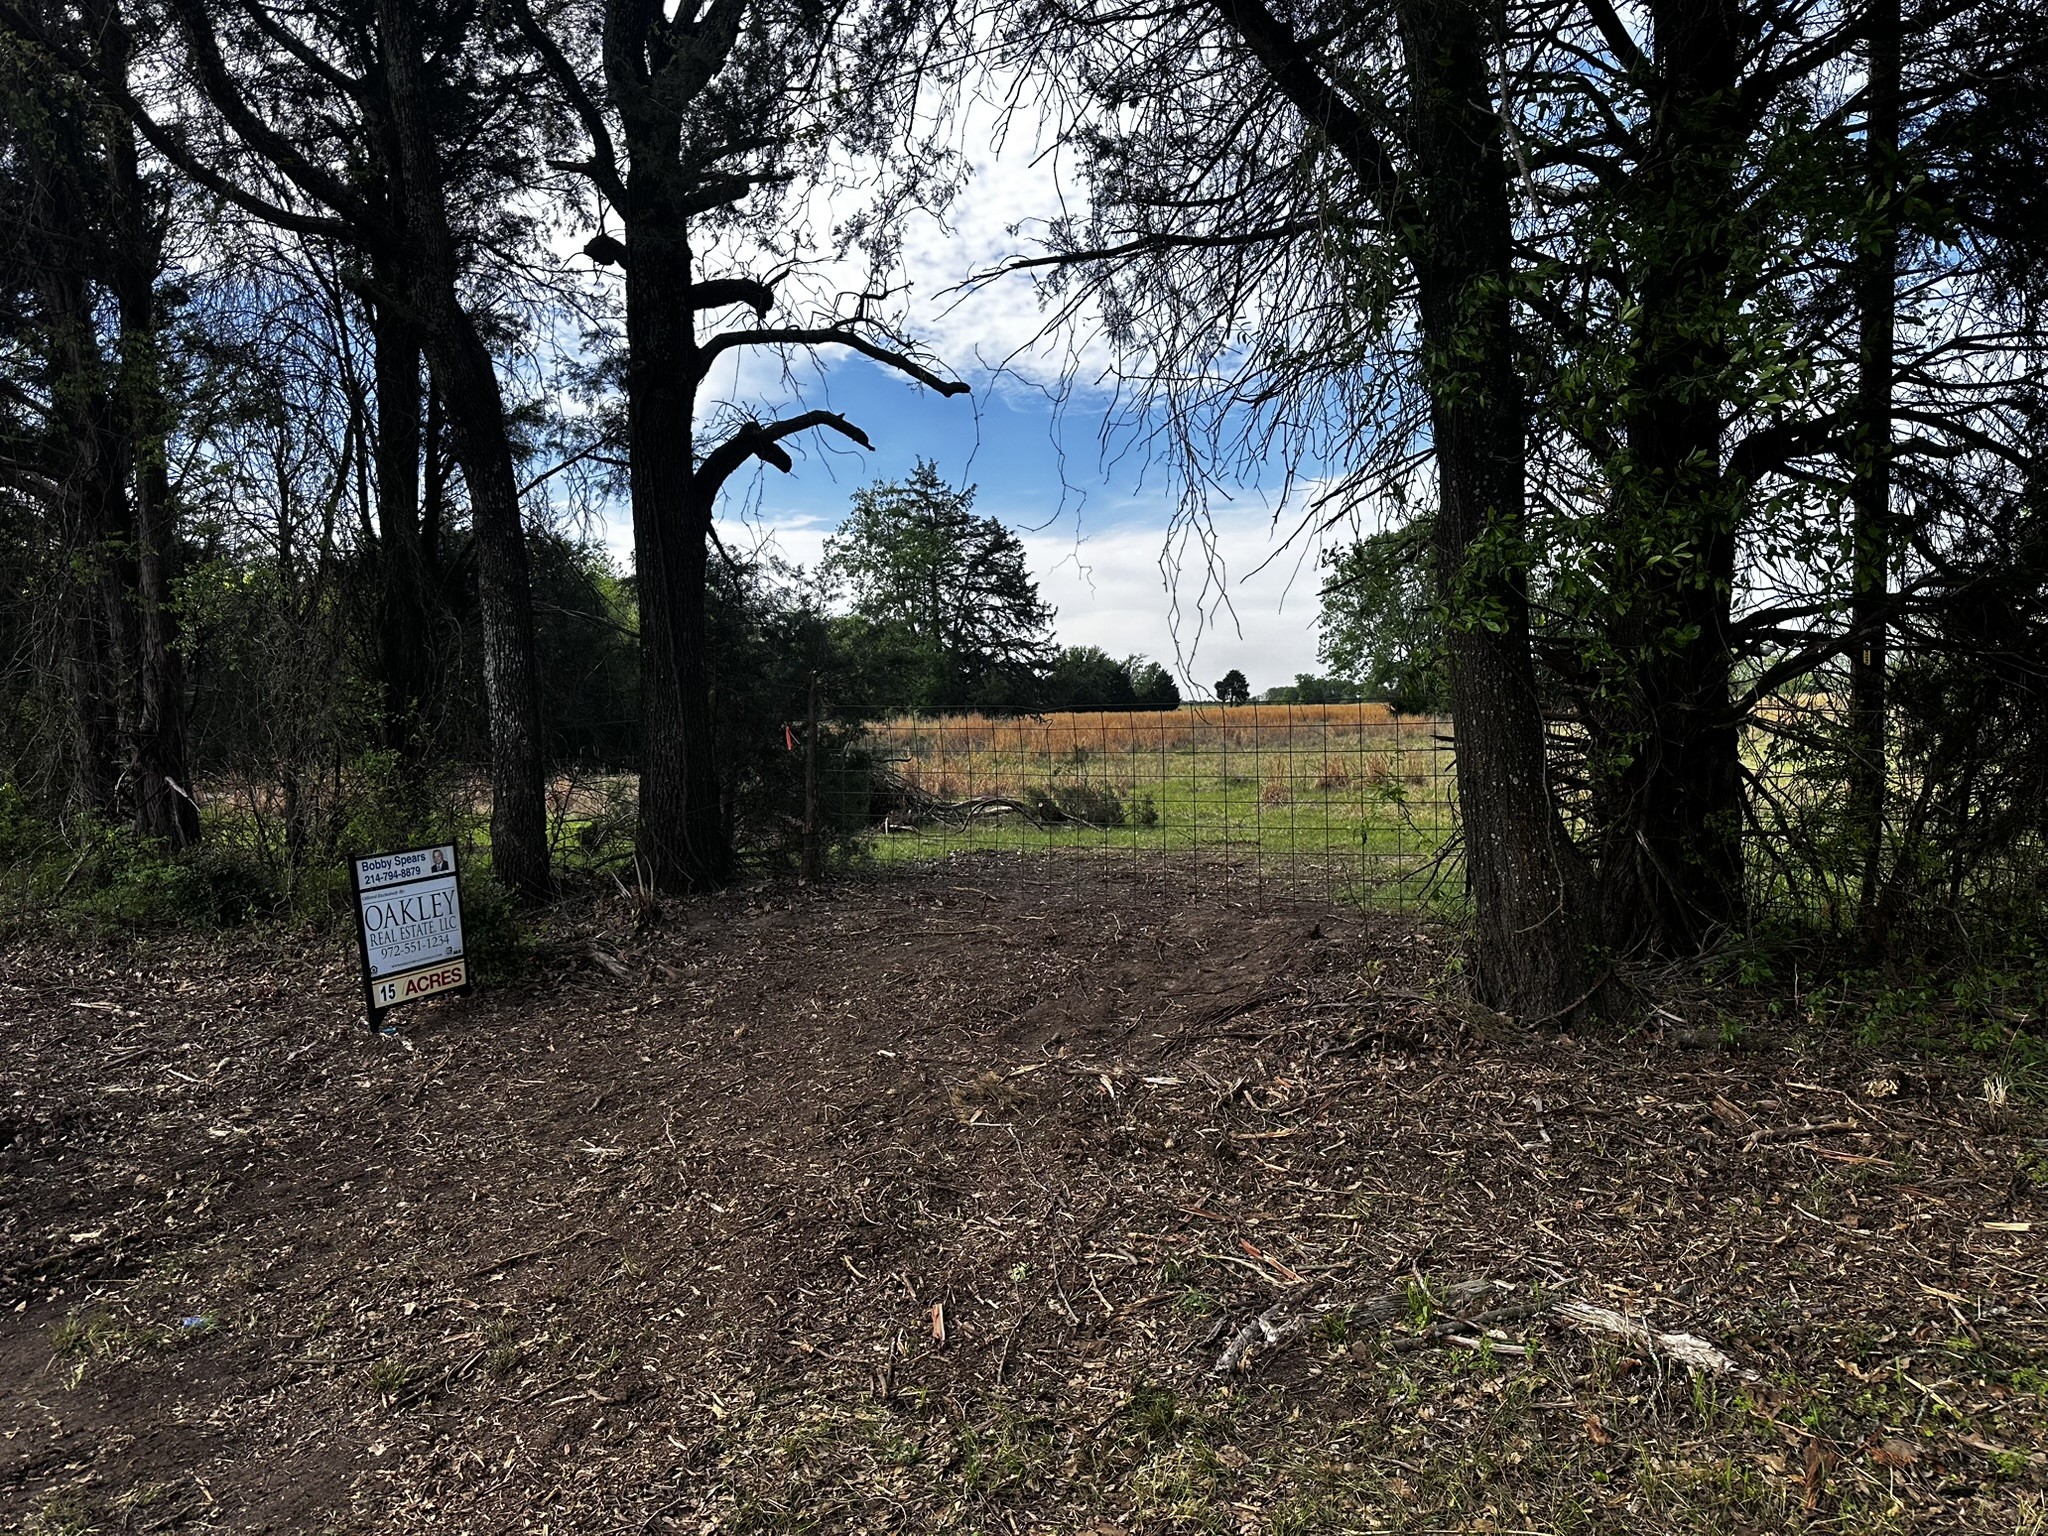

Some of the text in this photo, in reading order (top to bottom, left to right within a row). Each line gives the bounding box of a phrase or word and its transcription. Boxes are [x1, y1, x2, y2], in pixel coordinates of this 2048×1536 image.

[361, 853, 426, 872] Bobby Spears
[364, 866, 421, 885] 214-794-8879
[364, 889, 456, 932] OAKLEY
[369, 929, 397, 947] REAL
[438, 915, 457, 932] LLC
[381, 934, 450, 960] 972-551-1234
[380, 967, 462, 1002] 15 ACRES
